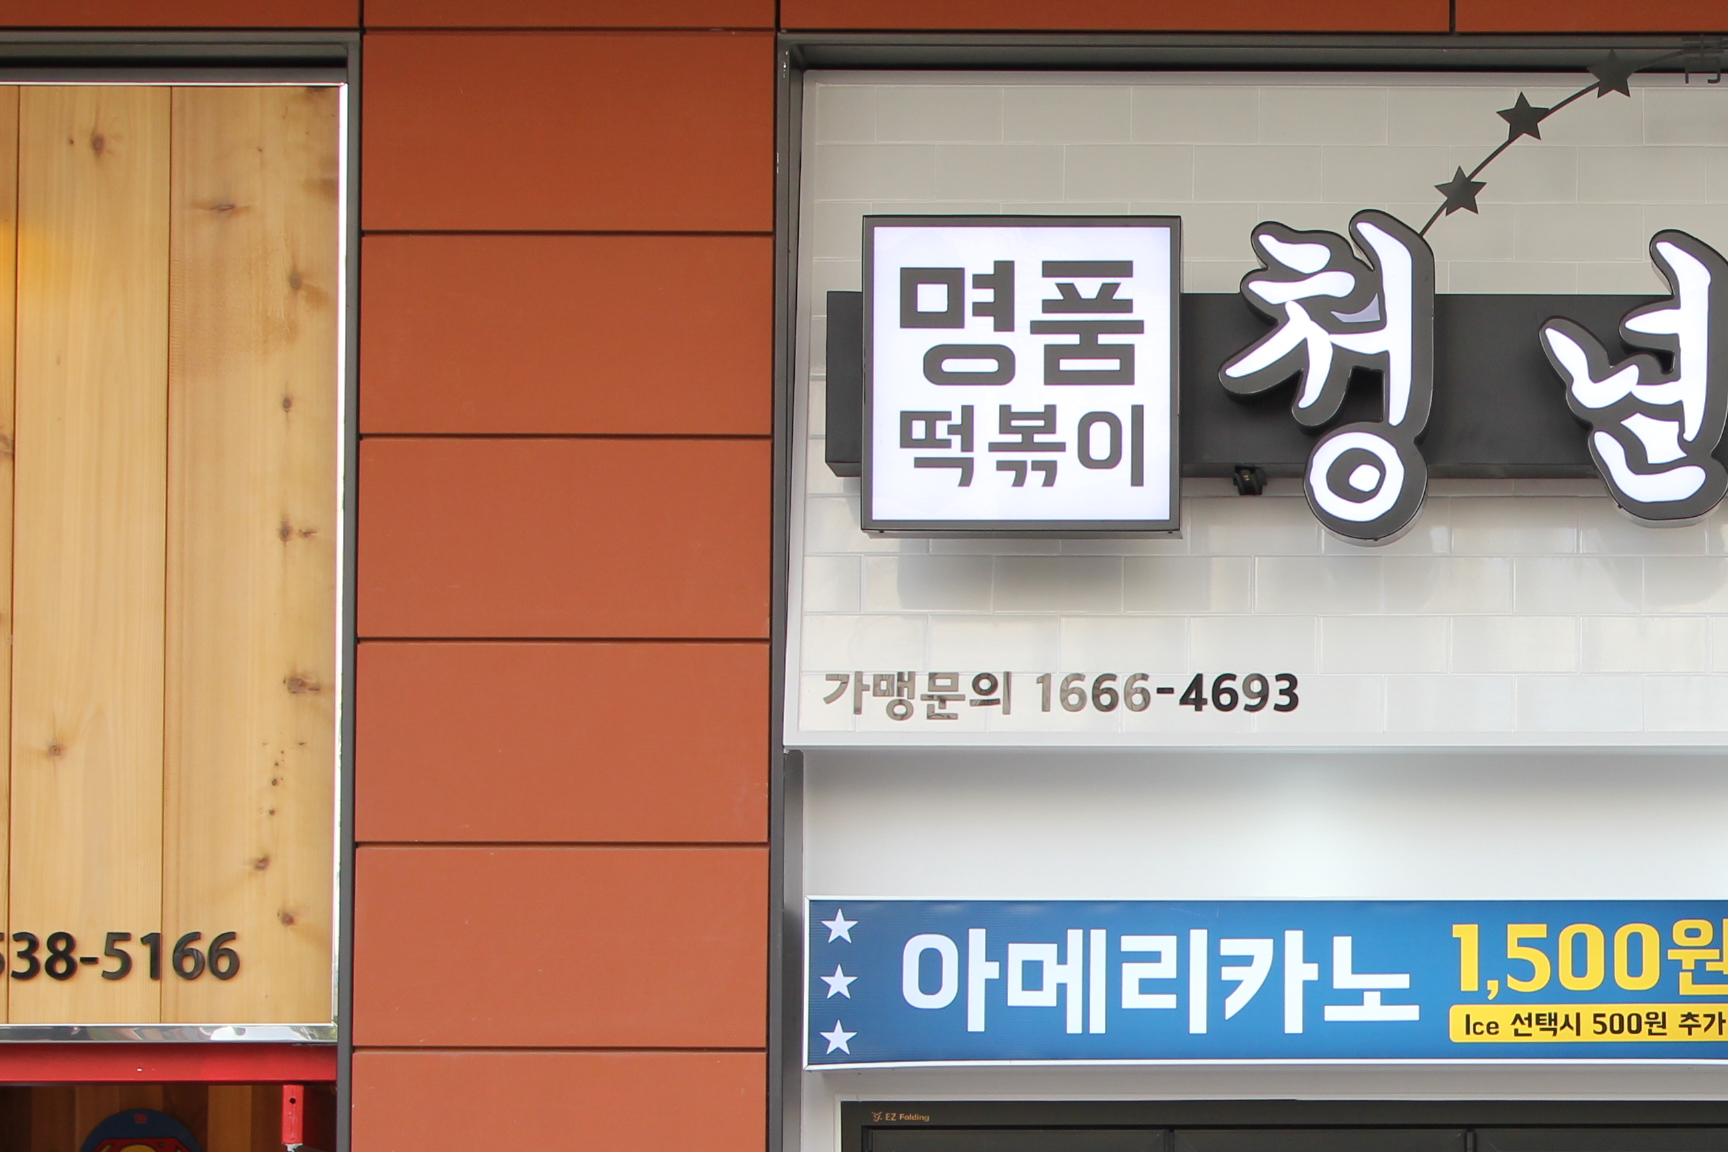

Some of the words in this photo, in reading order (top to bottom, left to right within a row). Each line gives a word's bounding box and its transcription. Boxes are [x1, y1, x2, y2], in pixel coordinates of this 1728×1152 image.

[899, 259, 1145, 387] 명품
[899, 403, 1145, 488] 떡볶이
[822, 670, 1012, 721] 가맹문의
[1036, 672, 1300, 714] 1666-4693
[0, 931, 241, 981] 38-5166
[901, 927, 1421, 1034] 아메리카노
[1464, 1013, 1500, 1036] Ice
[1510, 1012, 1582, 1037] 선택시
[1592, 1011, 1668, 1036] 500원
[1677, 1011, 1727, 1036] 추가
[885, 1112, 897, 1122] EZ
[899, 1113, 930, 1123] Folding
